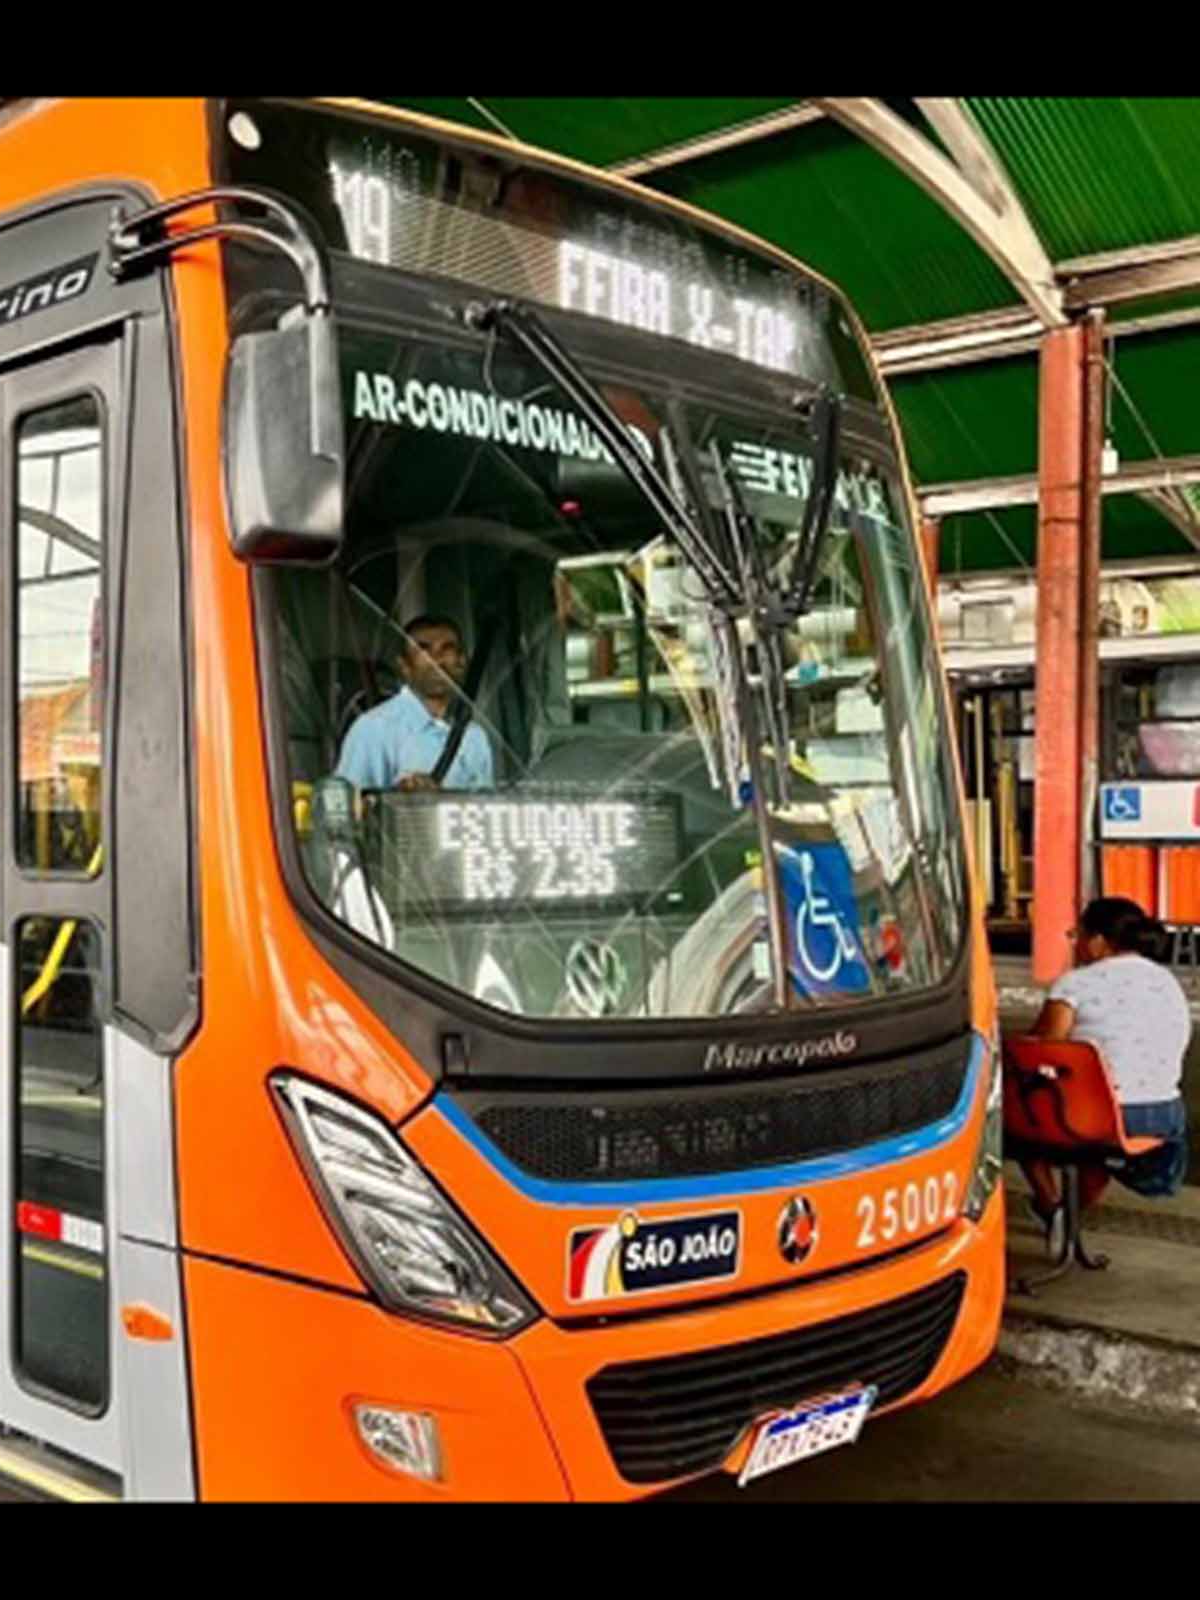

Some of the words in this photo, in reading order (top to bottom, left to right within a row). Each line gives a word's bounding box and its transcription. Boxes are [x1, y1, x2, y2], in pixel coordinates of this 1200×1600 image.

[558, 239, 669, 336] FEIRA
[437, 802, 638, 849] ESTUDANTE
[462, 848, 519, 899] R$
[703, 1031, 857, 1071] Marcopolo
[856, 1169, 958, 1248] 25002
[624, 1234, 676, 1271] SÃO
[678, 1225, 736, 1263] JOÃO
